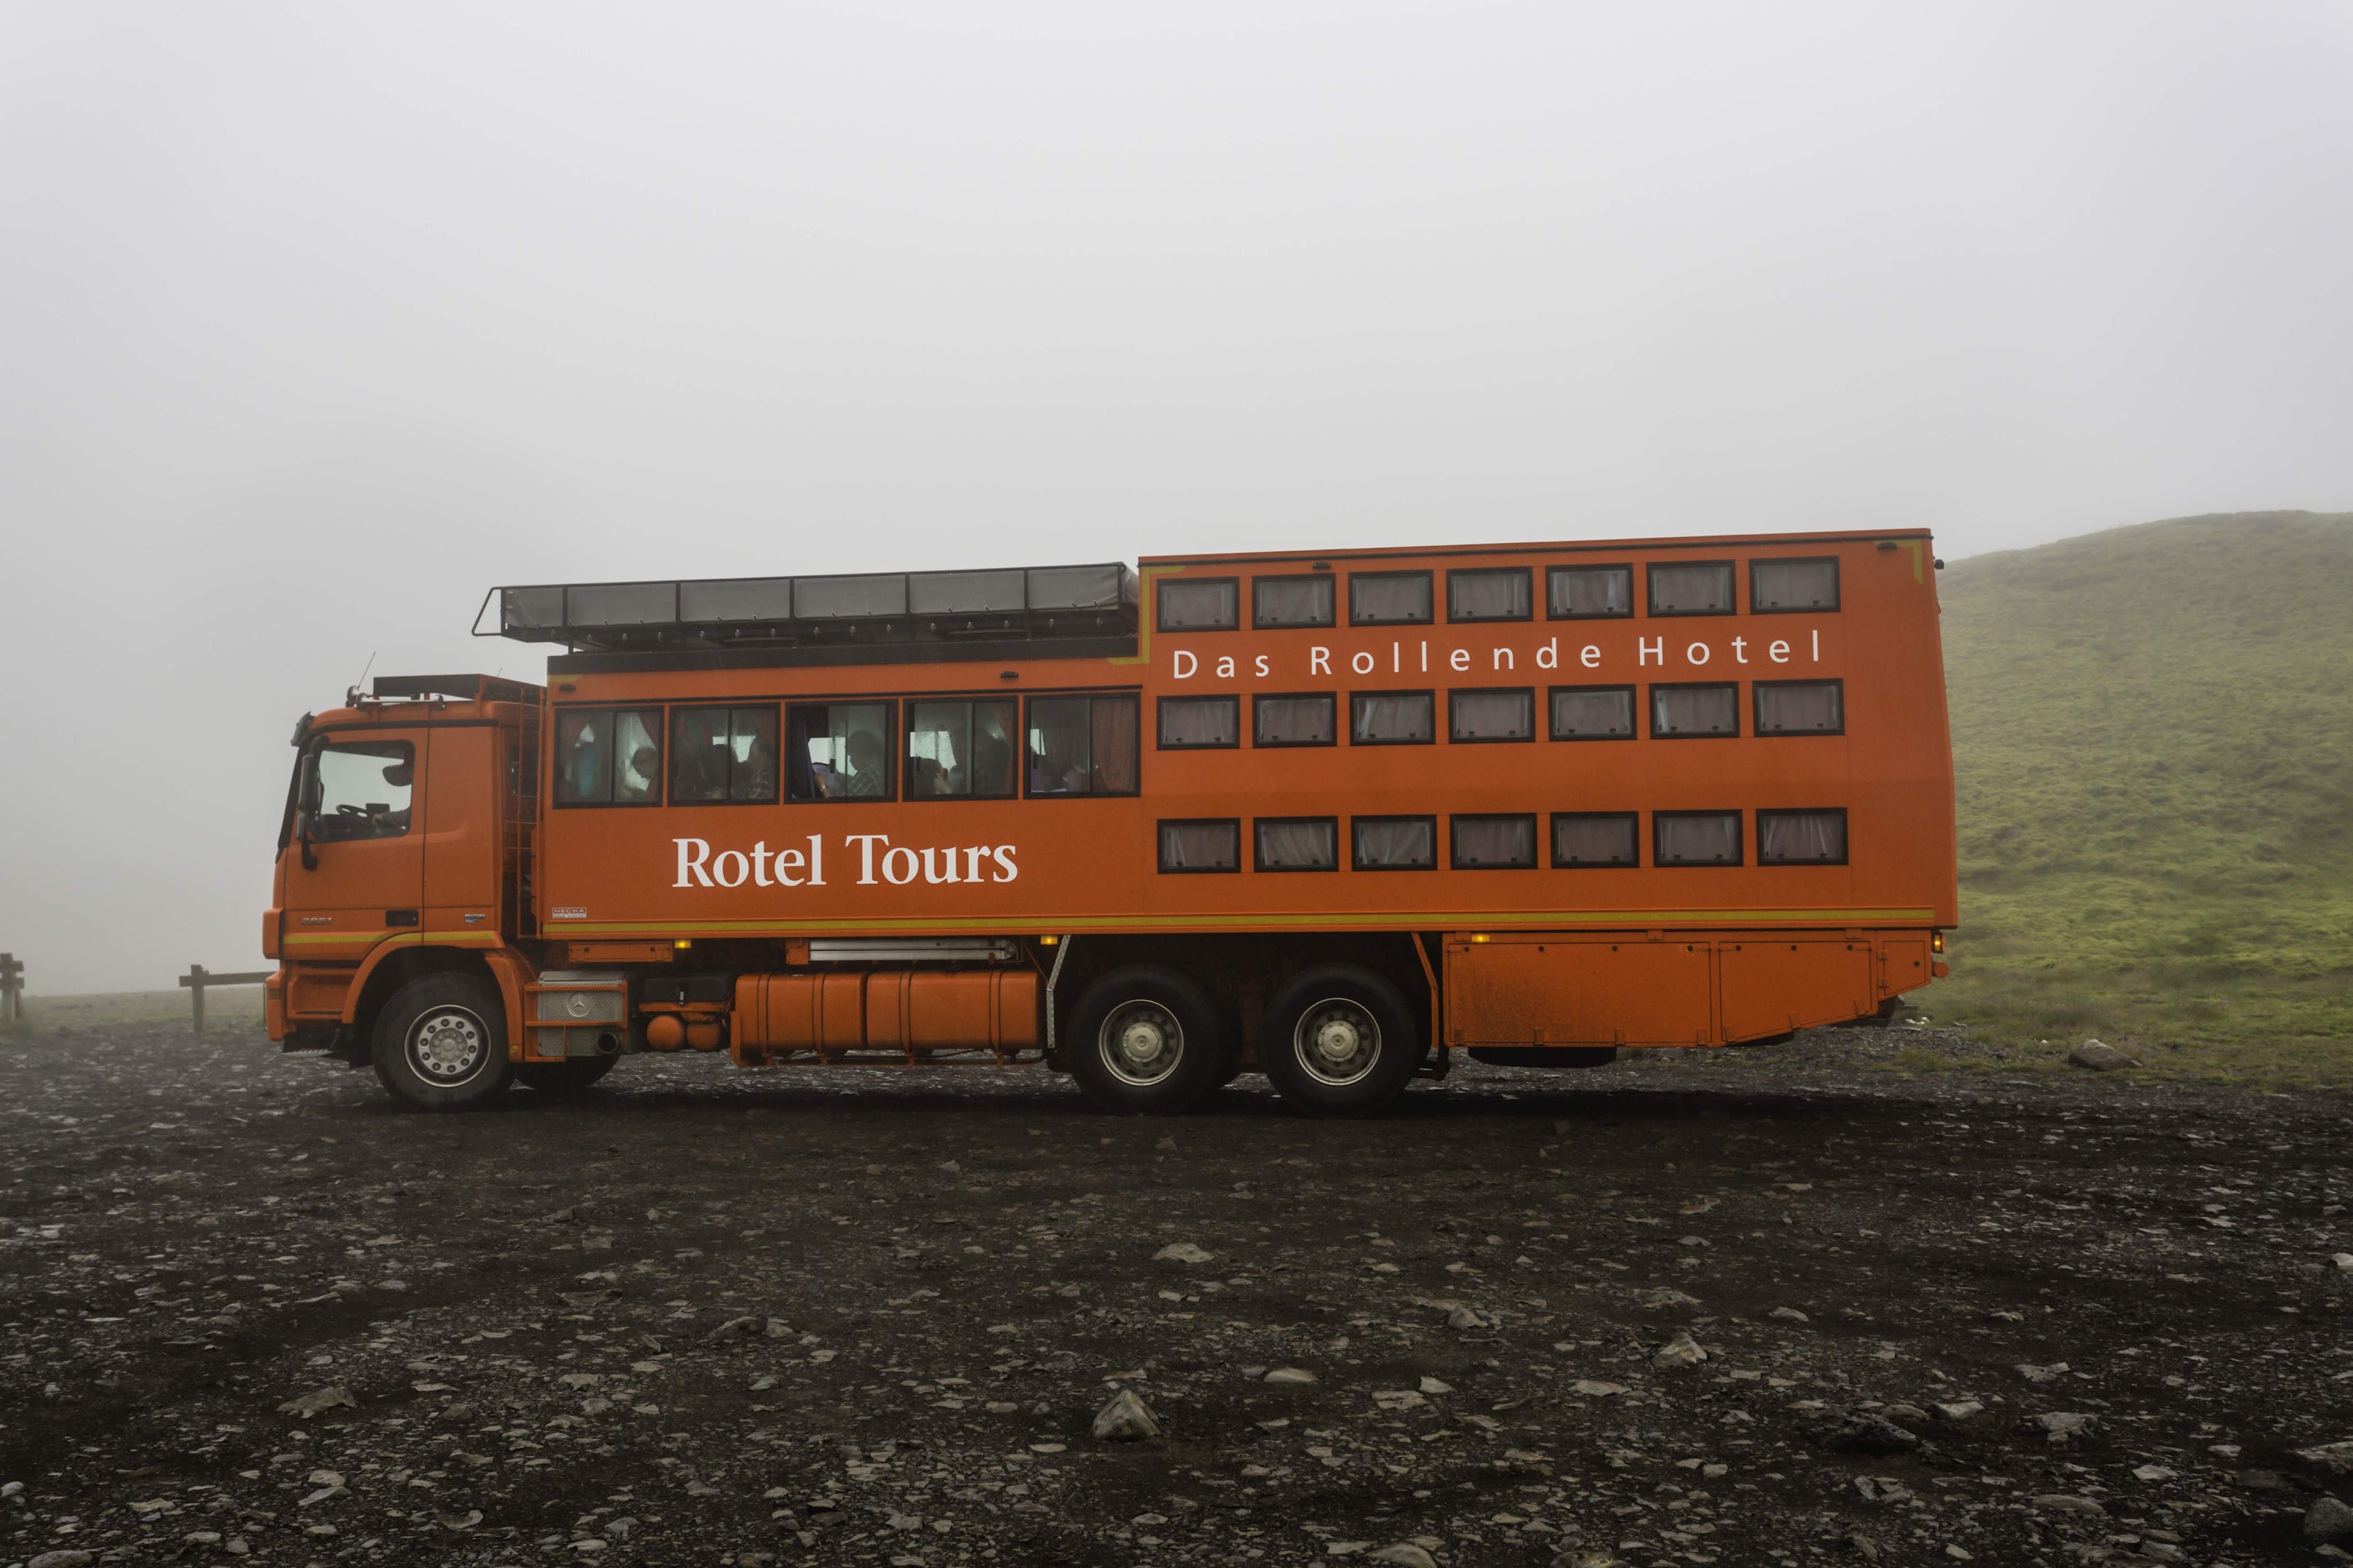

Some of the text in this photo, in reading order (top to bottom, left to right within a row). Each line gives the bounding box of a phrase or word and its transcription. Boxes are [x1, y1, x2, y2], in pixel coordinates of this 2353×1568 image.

[1174, 630, 1819, 679] Das Rollende Hotel
[672, 835, 1017, 887] Rotel Tours
